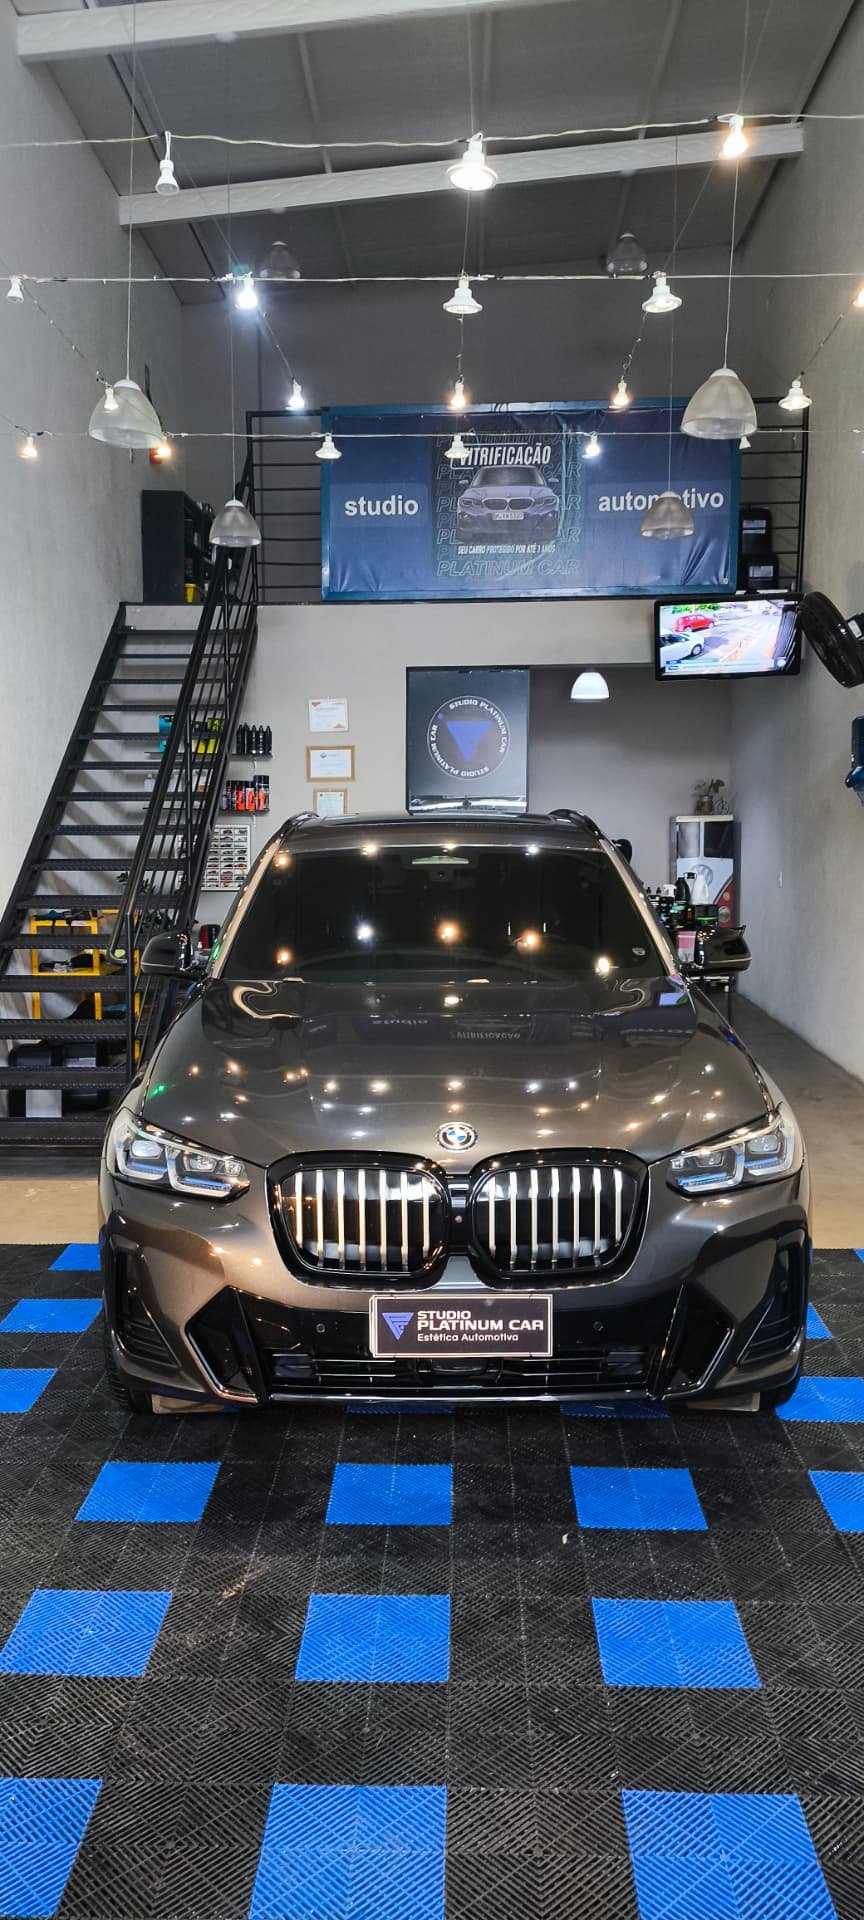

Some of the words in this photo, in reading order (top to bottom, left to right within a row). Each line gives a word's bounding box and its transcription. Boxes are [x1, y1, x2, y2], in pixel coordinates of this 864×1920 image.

[345, 495, 418, 516] studio
[598, 488, 724, 511] autotivo
[437, 560, 533, 577] PLATINUM
[538, 558, 581, 575] CAR
[430, 724, 438, 741] CAR
[449, 699, 478, 710] STUDIO
[480, 701, 507, 735] PLATINUM
[499, 736, 508, 753] CAR
[431, 743, 459, 775] PLATINUM
[460, 766, 490, 777] STUDIO
[417, 1310, 471, 1320] STUDIO
[417, 1319, 504, 1331] PLATINUM
[508, 1319, 544, 1331] CAR
[417, 1332, 459, 1342] Estética
[461, 1332, 519, 1342] Automotiva
